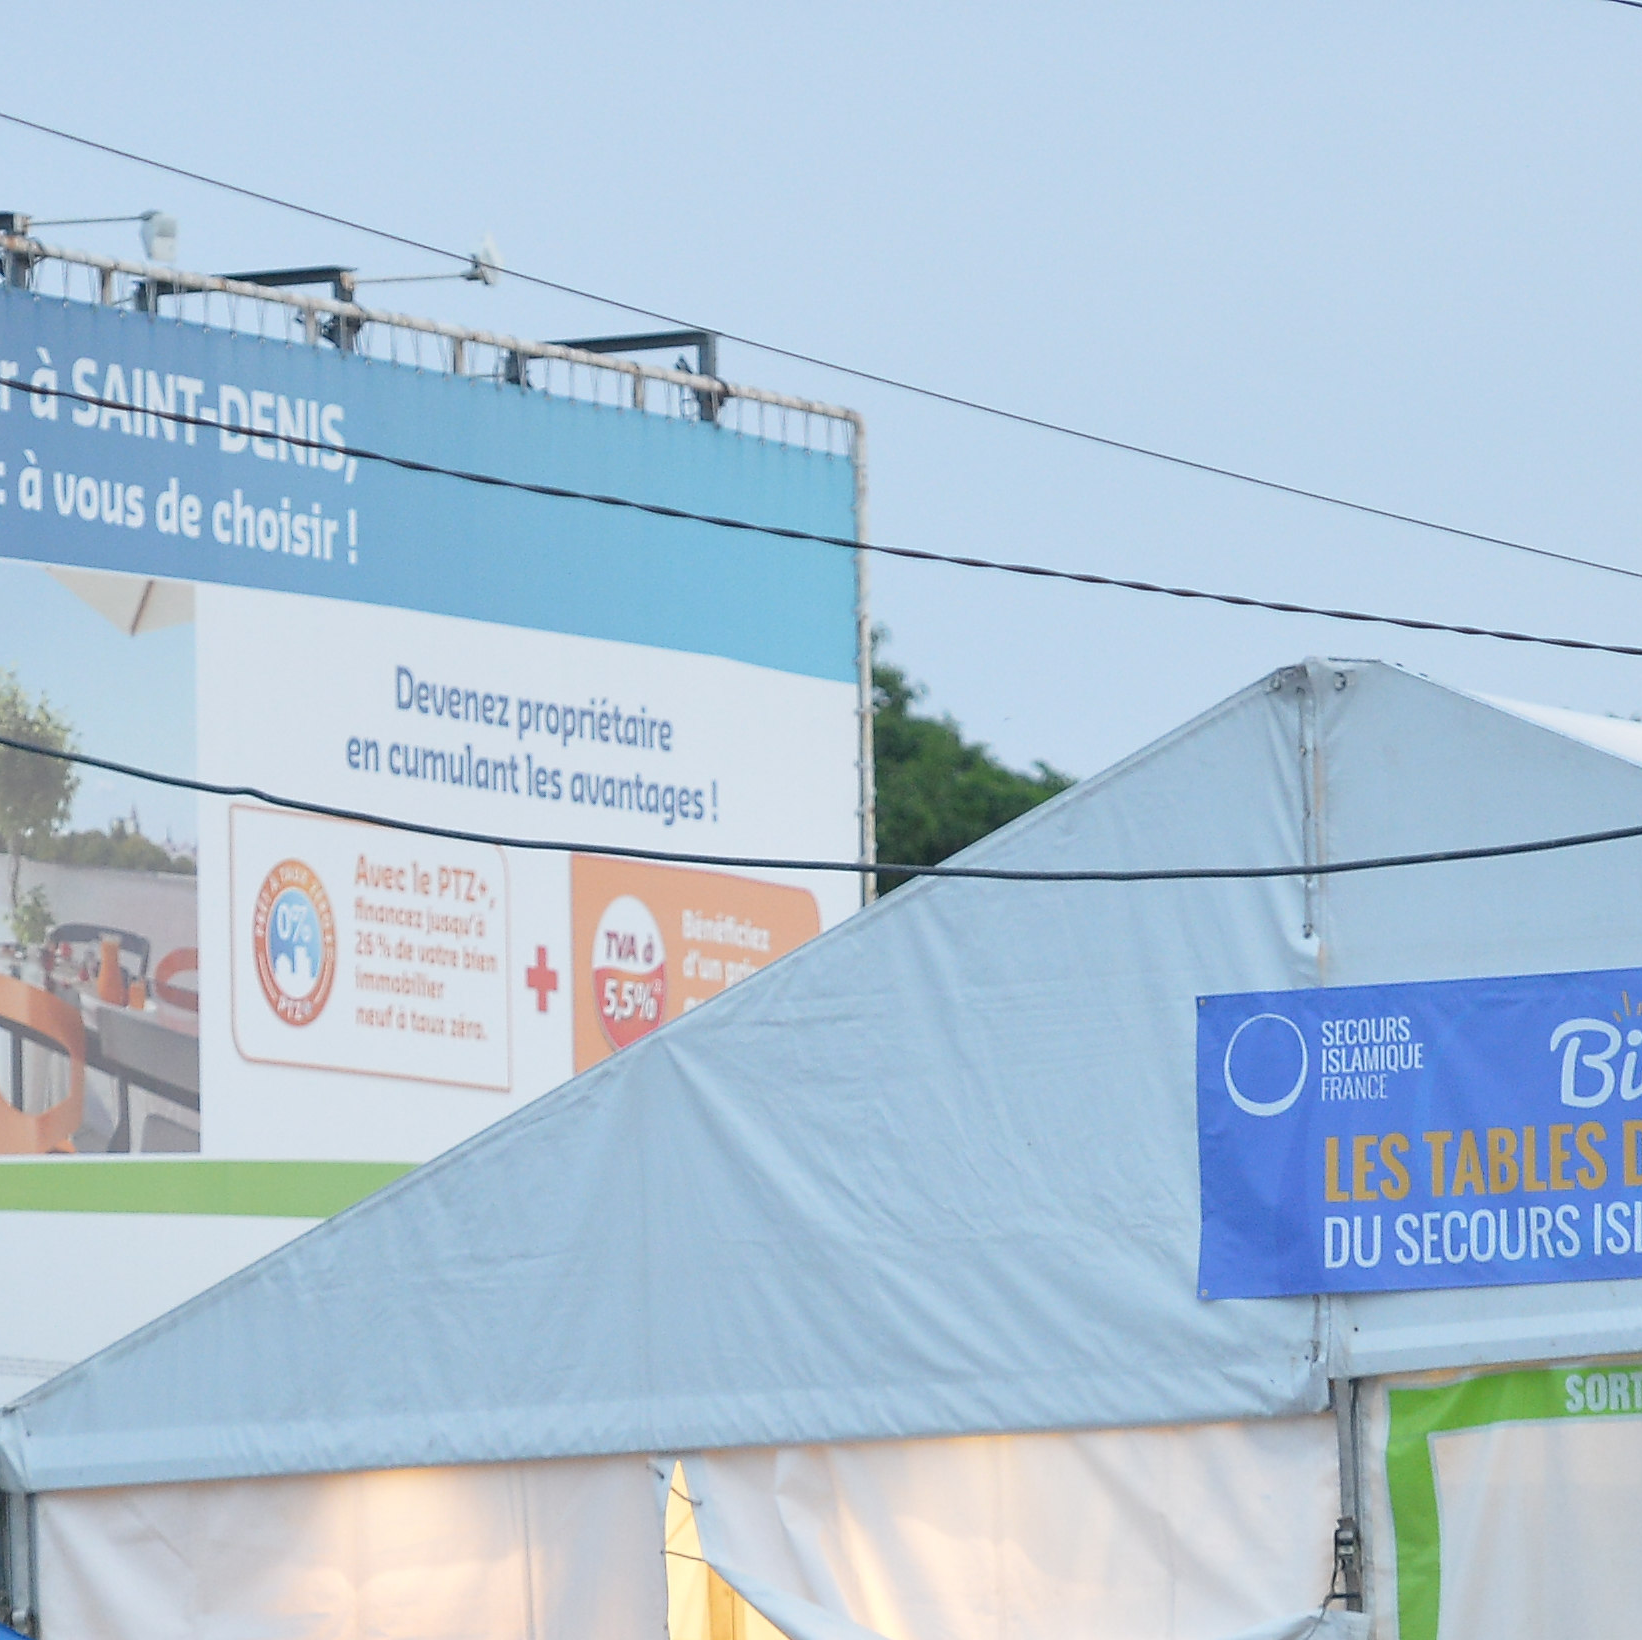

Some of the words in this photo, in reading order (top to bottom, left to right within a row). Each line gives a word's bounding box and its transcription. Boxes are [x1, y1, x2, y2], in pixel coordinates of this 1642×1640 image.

[30, 345, 58, 421] à
[71, 356, 357, 485] SAINT-DENIS,
[18, 448, 44, 511] à
[53, 470, 146, 529] vous
[156, 477, 201, 539] de
[212, 488, 340, 562] choisir
[396, 665, 510, 728] Devenez
[519, 697, 673, 752] propriétaire
[347, 737, 379, 772] en
[388, 744, 519, 795] cumulant
[527, 754, 562, 800] les
[571, 774, 704, 826] avantages
[355, 854, 406, 892] Avec
[413, 861, 431, 896] le
[276, 903, 313, 943] 0%
[681, 908, 771, 952] Bénéficiez
[395, 938, 414, 962] de
[604, 930, 638, 962] TVA
[643, 934, 654, 964] à
[355, 966, 446, 999] immobilier
[355, 1005, 394, 1029] neuf
[1321, 1015, 1411, 1047] SECOURS
[1321, 1042, 1424, 1074] ISLAMIQUE
[1321, 1073, 1388, 1102] FRANCE
[1324, 1132, 1412, 1203] LES
[1421, 1120, 1608, 1198] TABLES
[1323, 1214, 1382, 1270] DU
[1394, 1203, 1582, 1267] SECOURS
